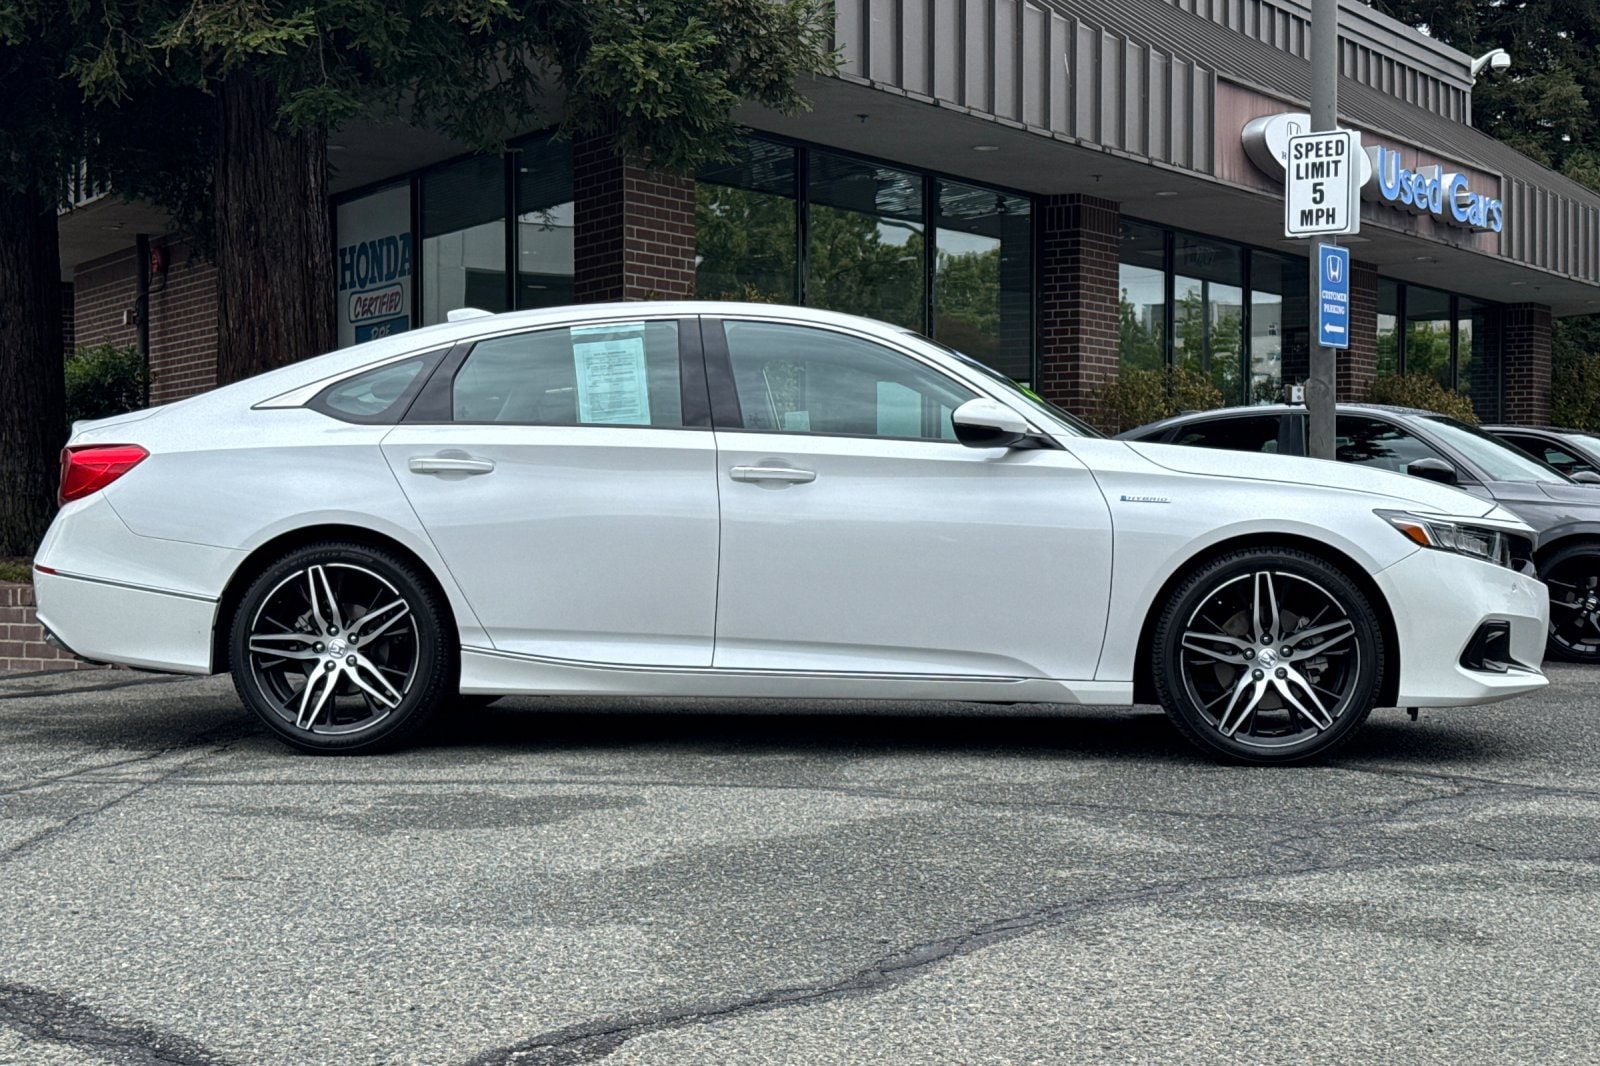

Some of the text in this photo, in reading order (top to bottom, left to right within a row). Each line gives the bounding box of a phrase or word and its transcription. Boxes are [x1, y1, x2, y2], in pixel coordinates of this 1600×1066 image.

[1293, 139, 1345, 160] SPEED
[1295, 160, 1341, 181] LIMIT
[1311, 182, 1325, 205] 5
[1379, 146, 1503, 233] Used Cars
[1300, 207, 1336, 227] MPH
[339, 233, 412, 291] HONDA
[354, 292, 401, 319] CERTIFIED
[1322, 290, 1347, 302] CUSTOMER
[1323, 303, 1345, 315] PARKING
